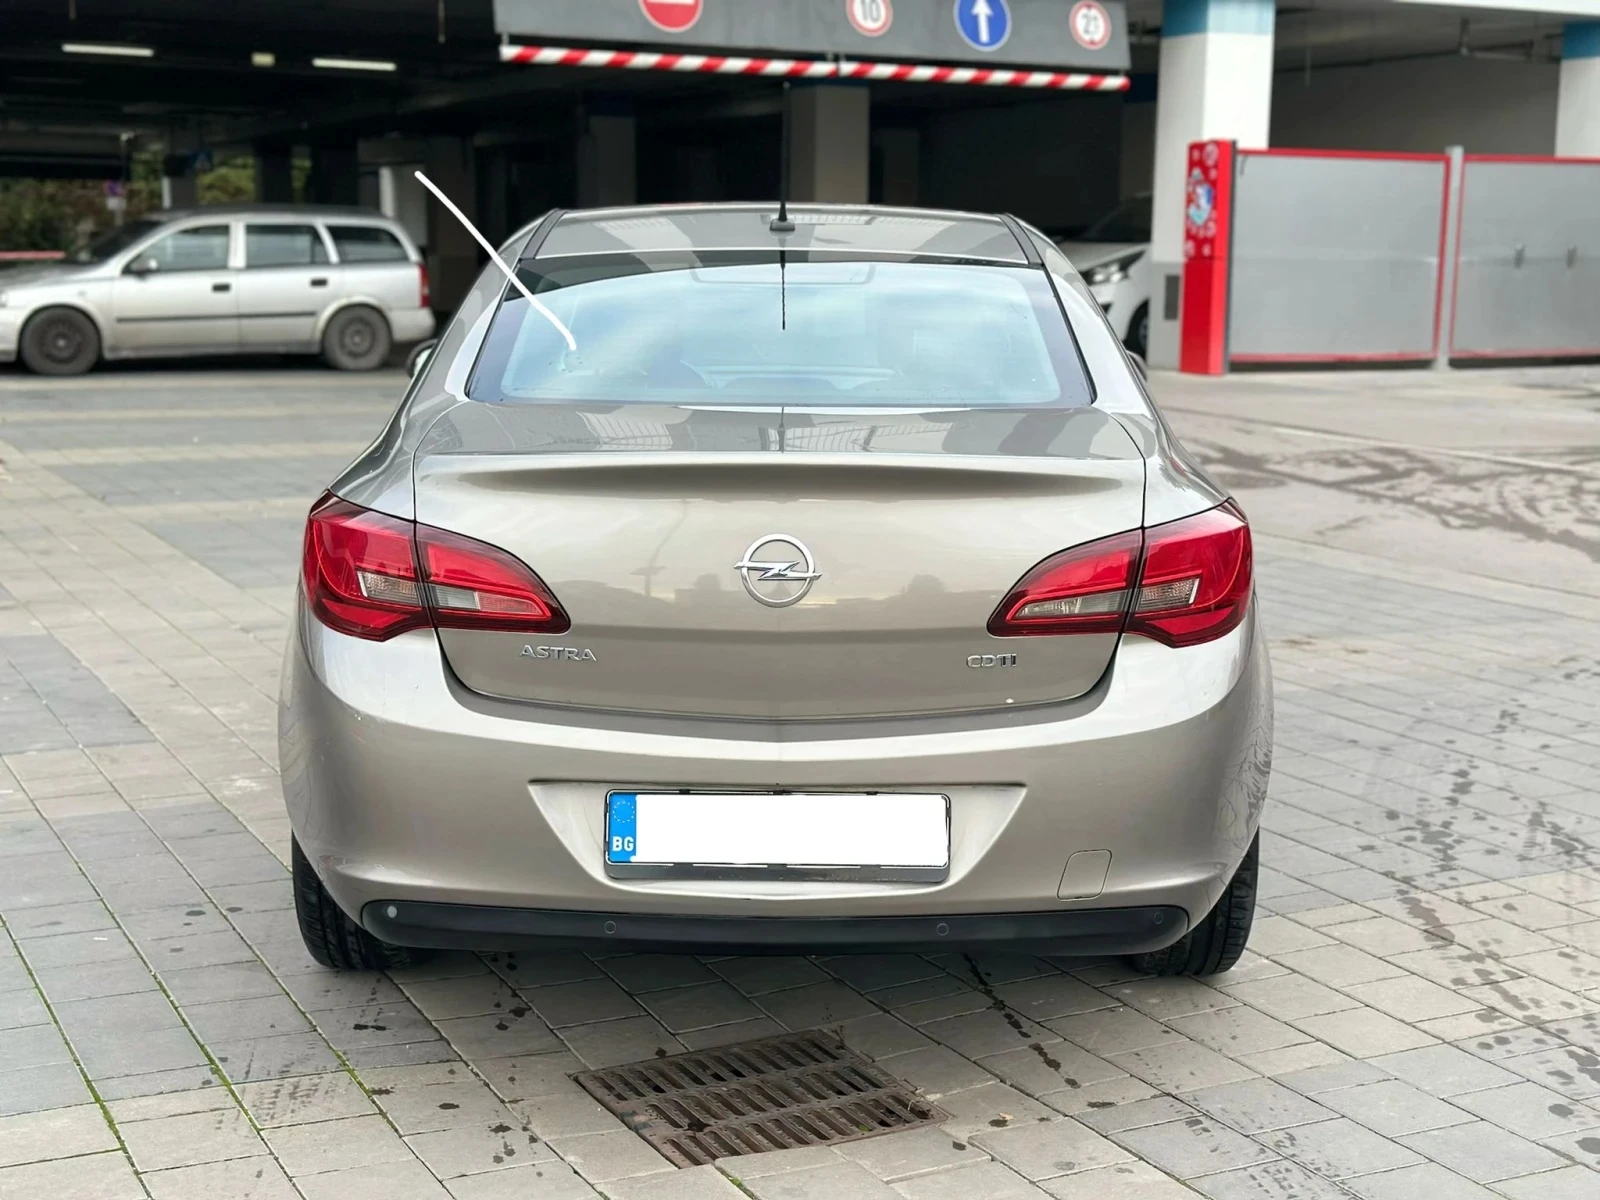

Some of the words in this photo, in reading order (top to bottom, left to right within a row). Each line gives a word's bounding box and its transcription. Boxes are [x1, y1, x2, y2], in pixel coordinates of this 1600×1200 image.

[519, 644, 597, 662] ASTRA
[966, 653, 1017, 668] CDTI
[612, 836, 634, 852] BG
